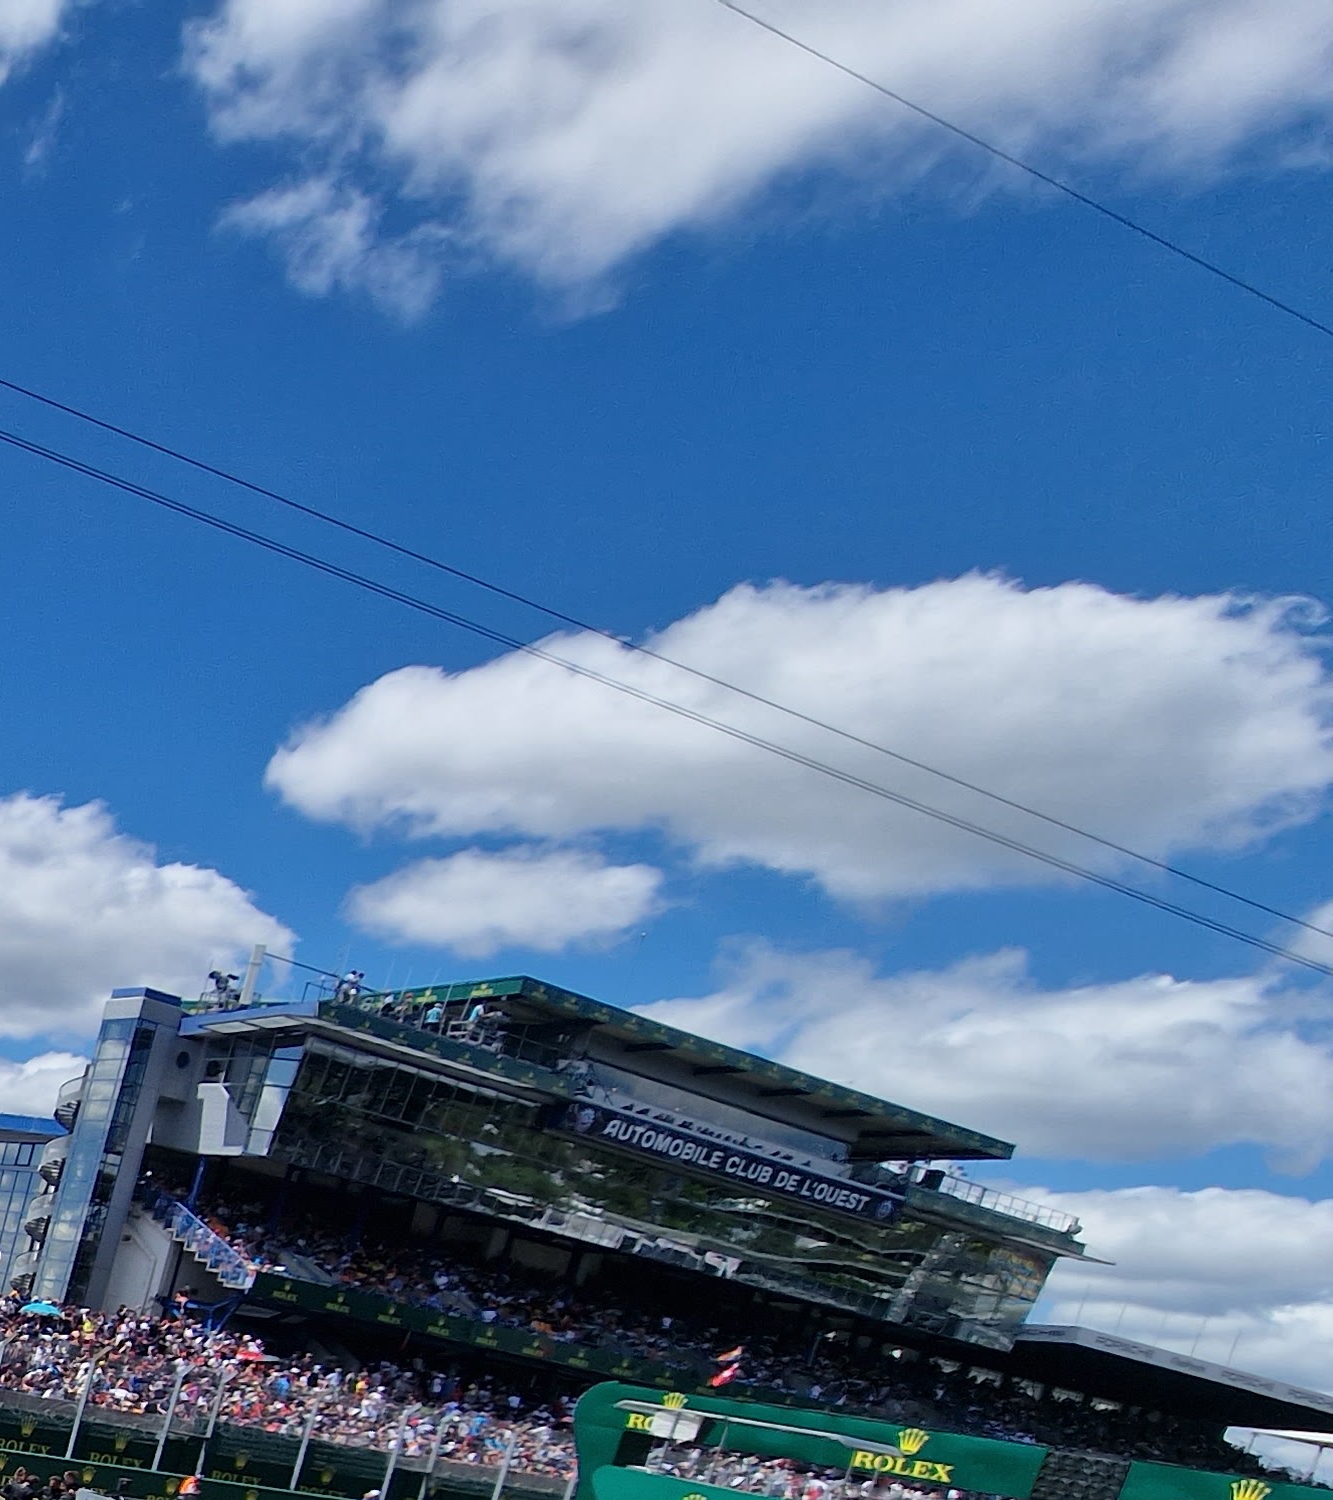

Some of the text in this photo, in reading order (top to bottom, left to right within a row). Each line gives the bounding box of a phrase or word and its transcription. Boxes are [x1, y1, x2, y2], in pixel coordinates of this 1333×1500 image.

[602, 1119, 872, 1213] AUTOMOBILE CLUB DE L'OUEST
[851, 1450, 956, 1484] ROLEX
